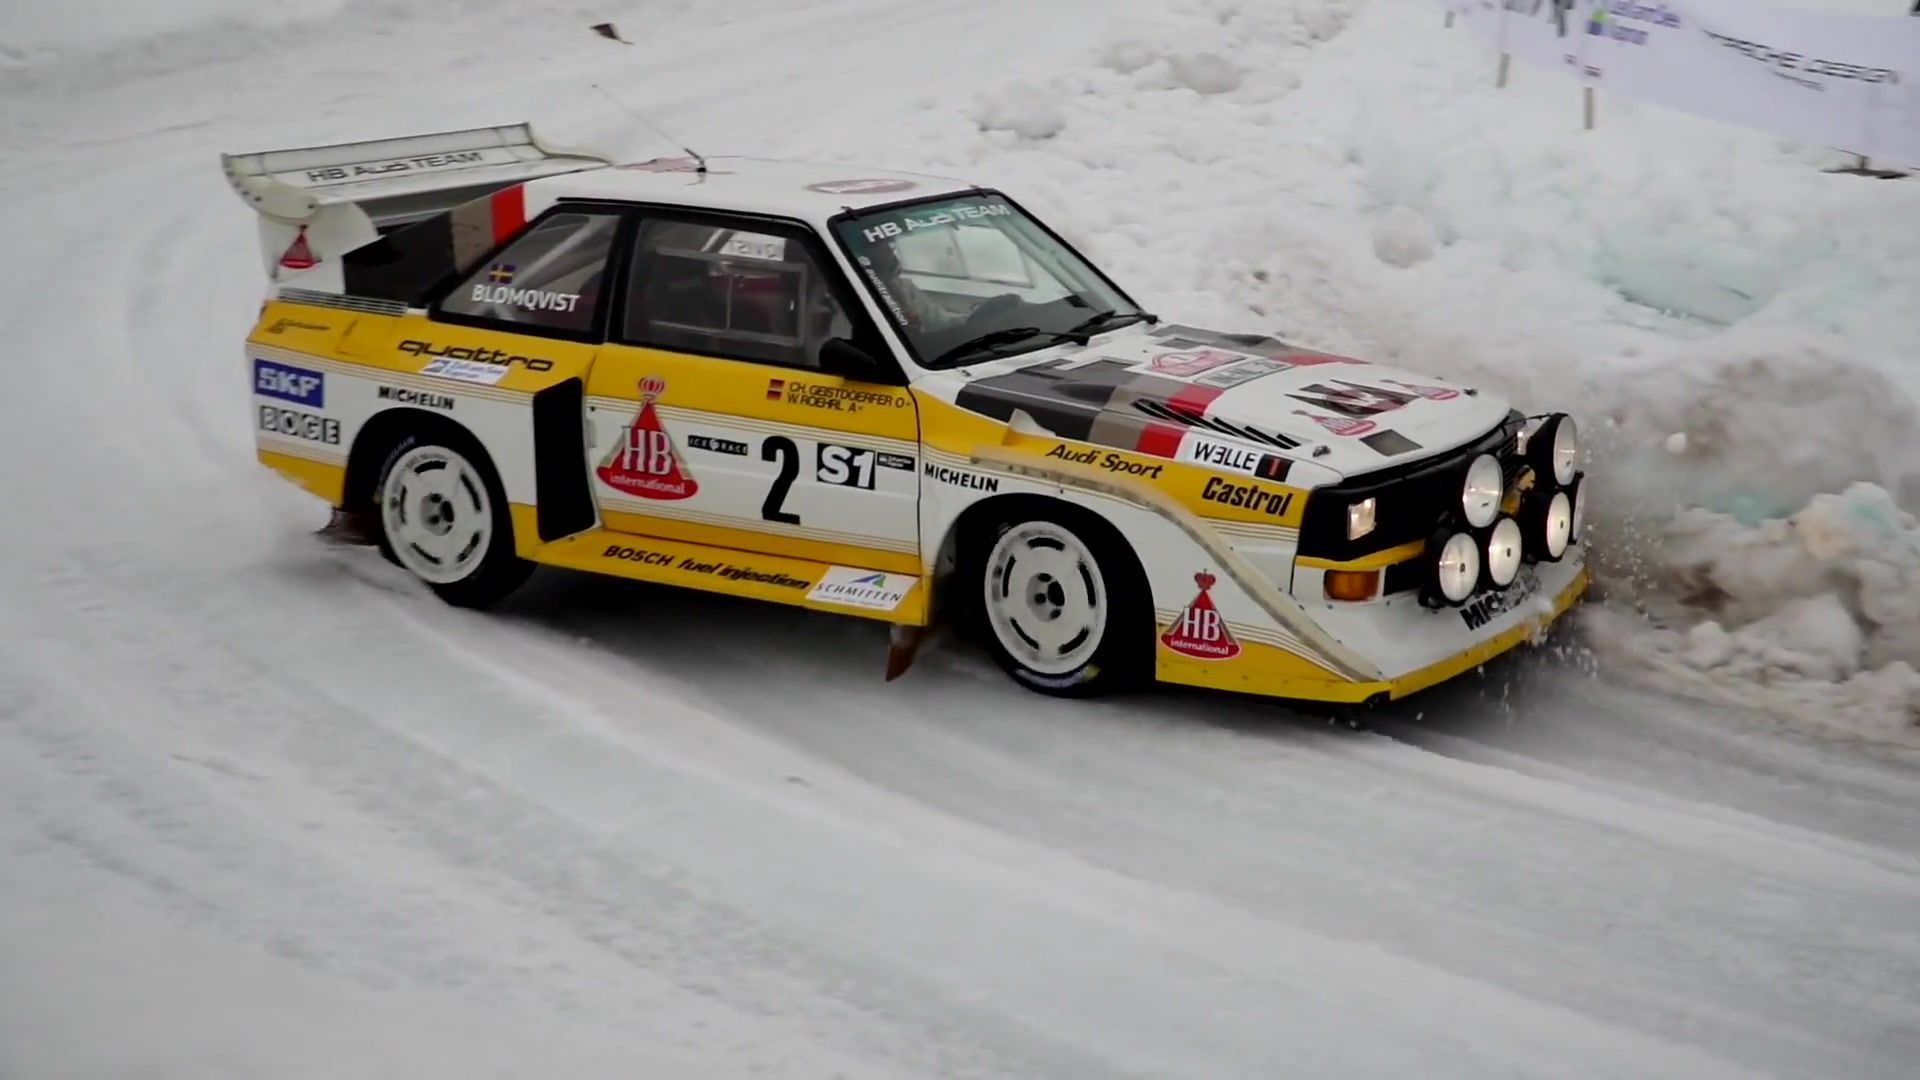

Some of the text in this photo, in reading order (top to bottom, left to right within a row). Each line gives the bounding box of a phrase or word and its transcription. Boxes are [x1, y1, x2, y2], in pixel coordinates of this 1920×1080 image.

[307, 168, 348, 182] HB
[410, 152, 483, 168] TEAM
[862, 222, 903, 243] HB
[951, 204, 1011, 221] TEAM
[471, 285, 580, 313] BLOMQVIST
[398, 340, 555, 372] quattro
[258, 367, 321, 398] SKF
[377, 386, 455, 410] MICHELIN
[260, 405, 341, 445] BOGE
[621, 425, 673, 476] HB
[818, 445, 876, 489] S1
[1046, 443, 1164, 480] Audi Sport
[610, 471, 686, 495] international
[761, 435, 801, 525] 2
[924, 464, 1000, 493] MICHELIN
[1202, 476, 1295, 518] Castrol
[602, 544, 811, 590] BOSCH fuel injection
[815, 581, 903, 602] SCHMITTEN
[1182, 606, 1221, 642] HB
[1169, 638, 1230, 656] international
